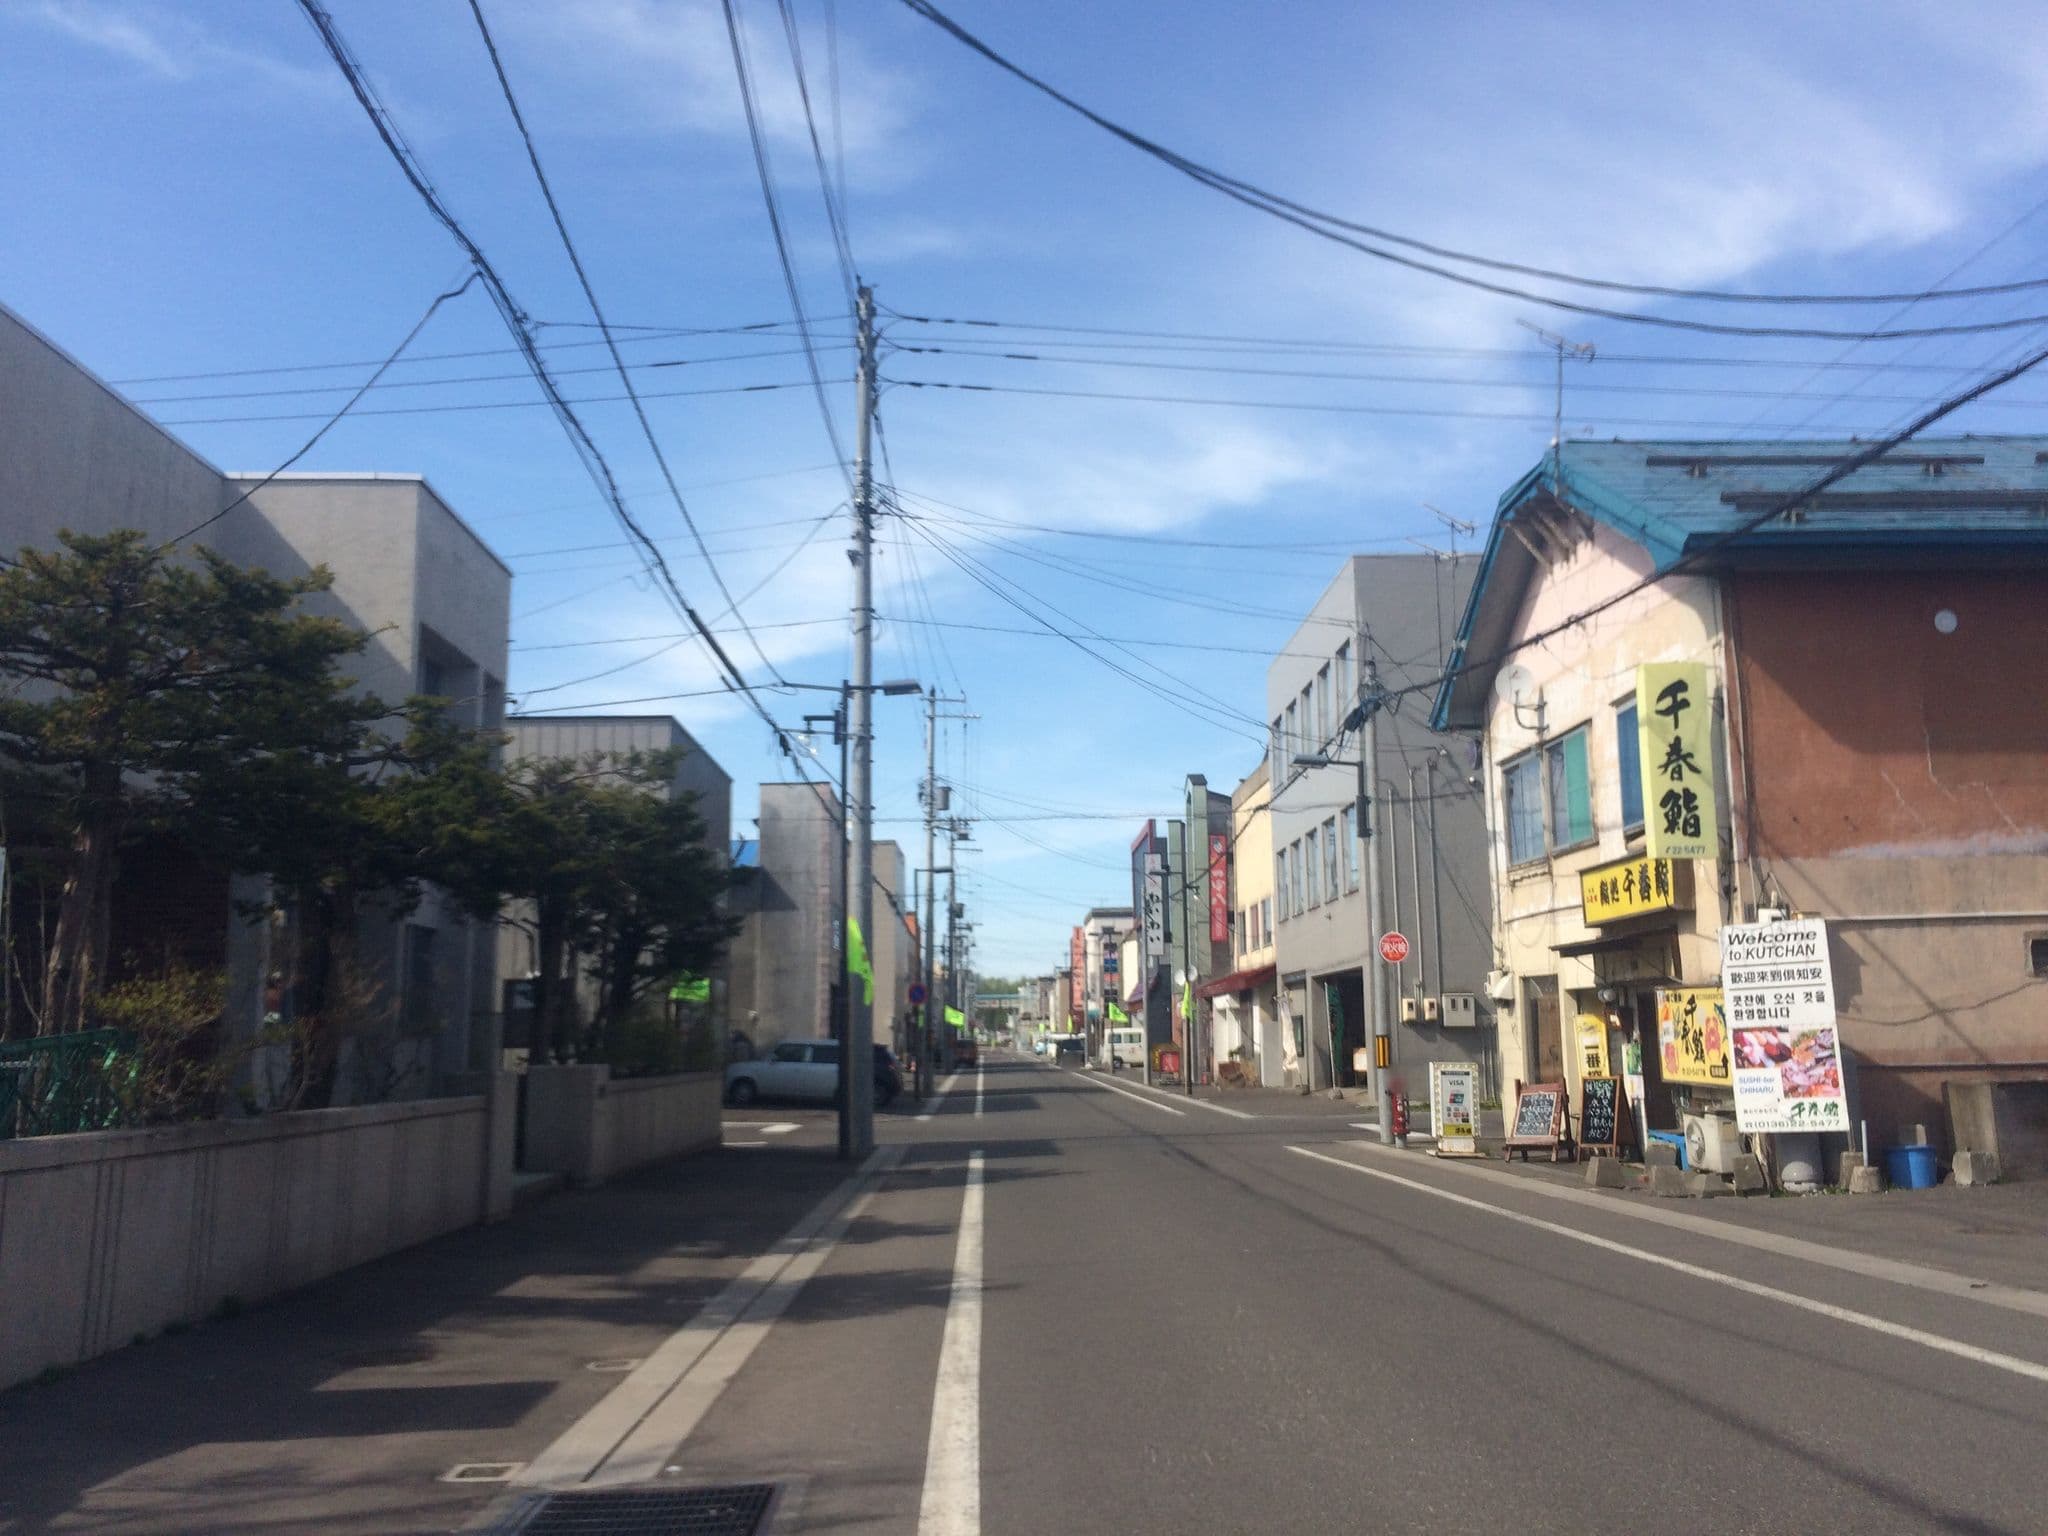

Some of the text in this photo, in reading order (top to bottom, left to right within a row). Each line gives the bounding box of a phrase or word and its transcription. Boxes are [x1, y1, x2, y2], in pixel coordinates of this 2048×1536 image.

[1655, 680, 1702, 838] 千春鮨
[1728, 931, 1817, 945] Welcome
[1729, 943, 1816, 961] to KUTCHAN
[1773, 991, 1795, 1005] 오신
[1803, 990, 1825, 1003] 것을
